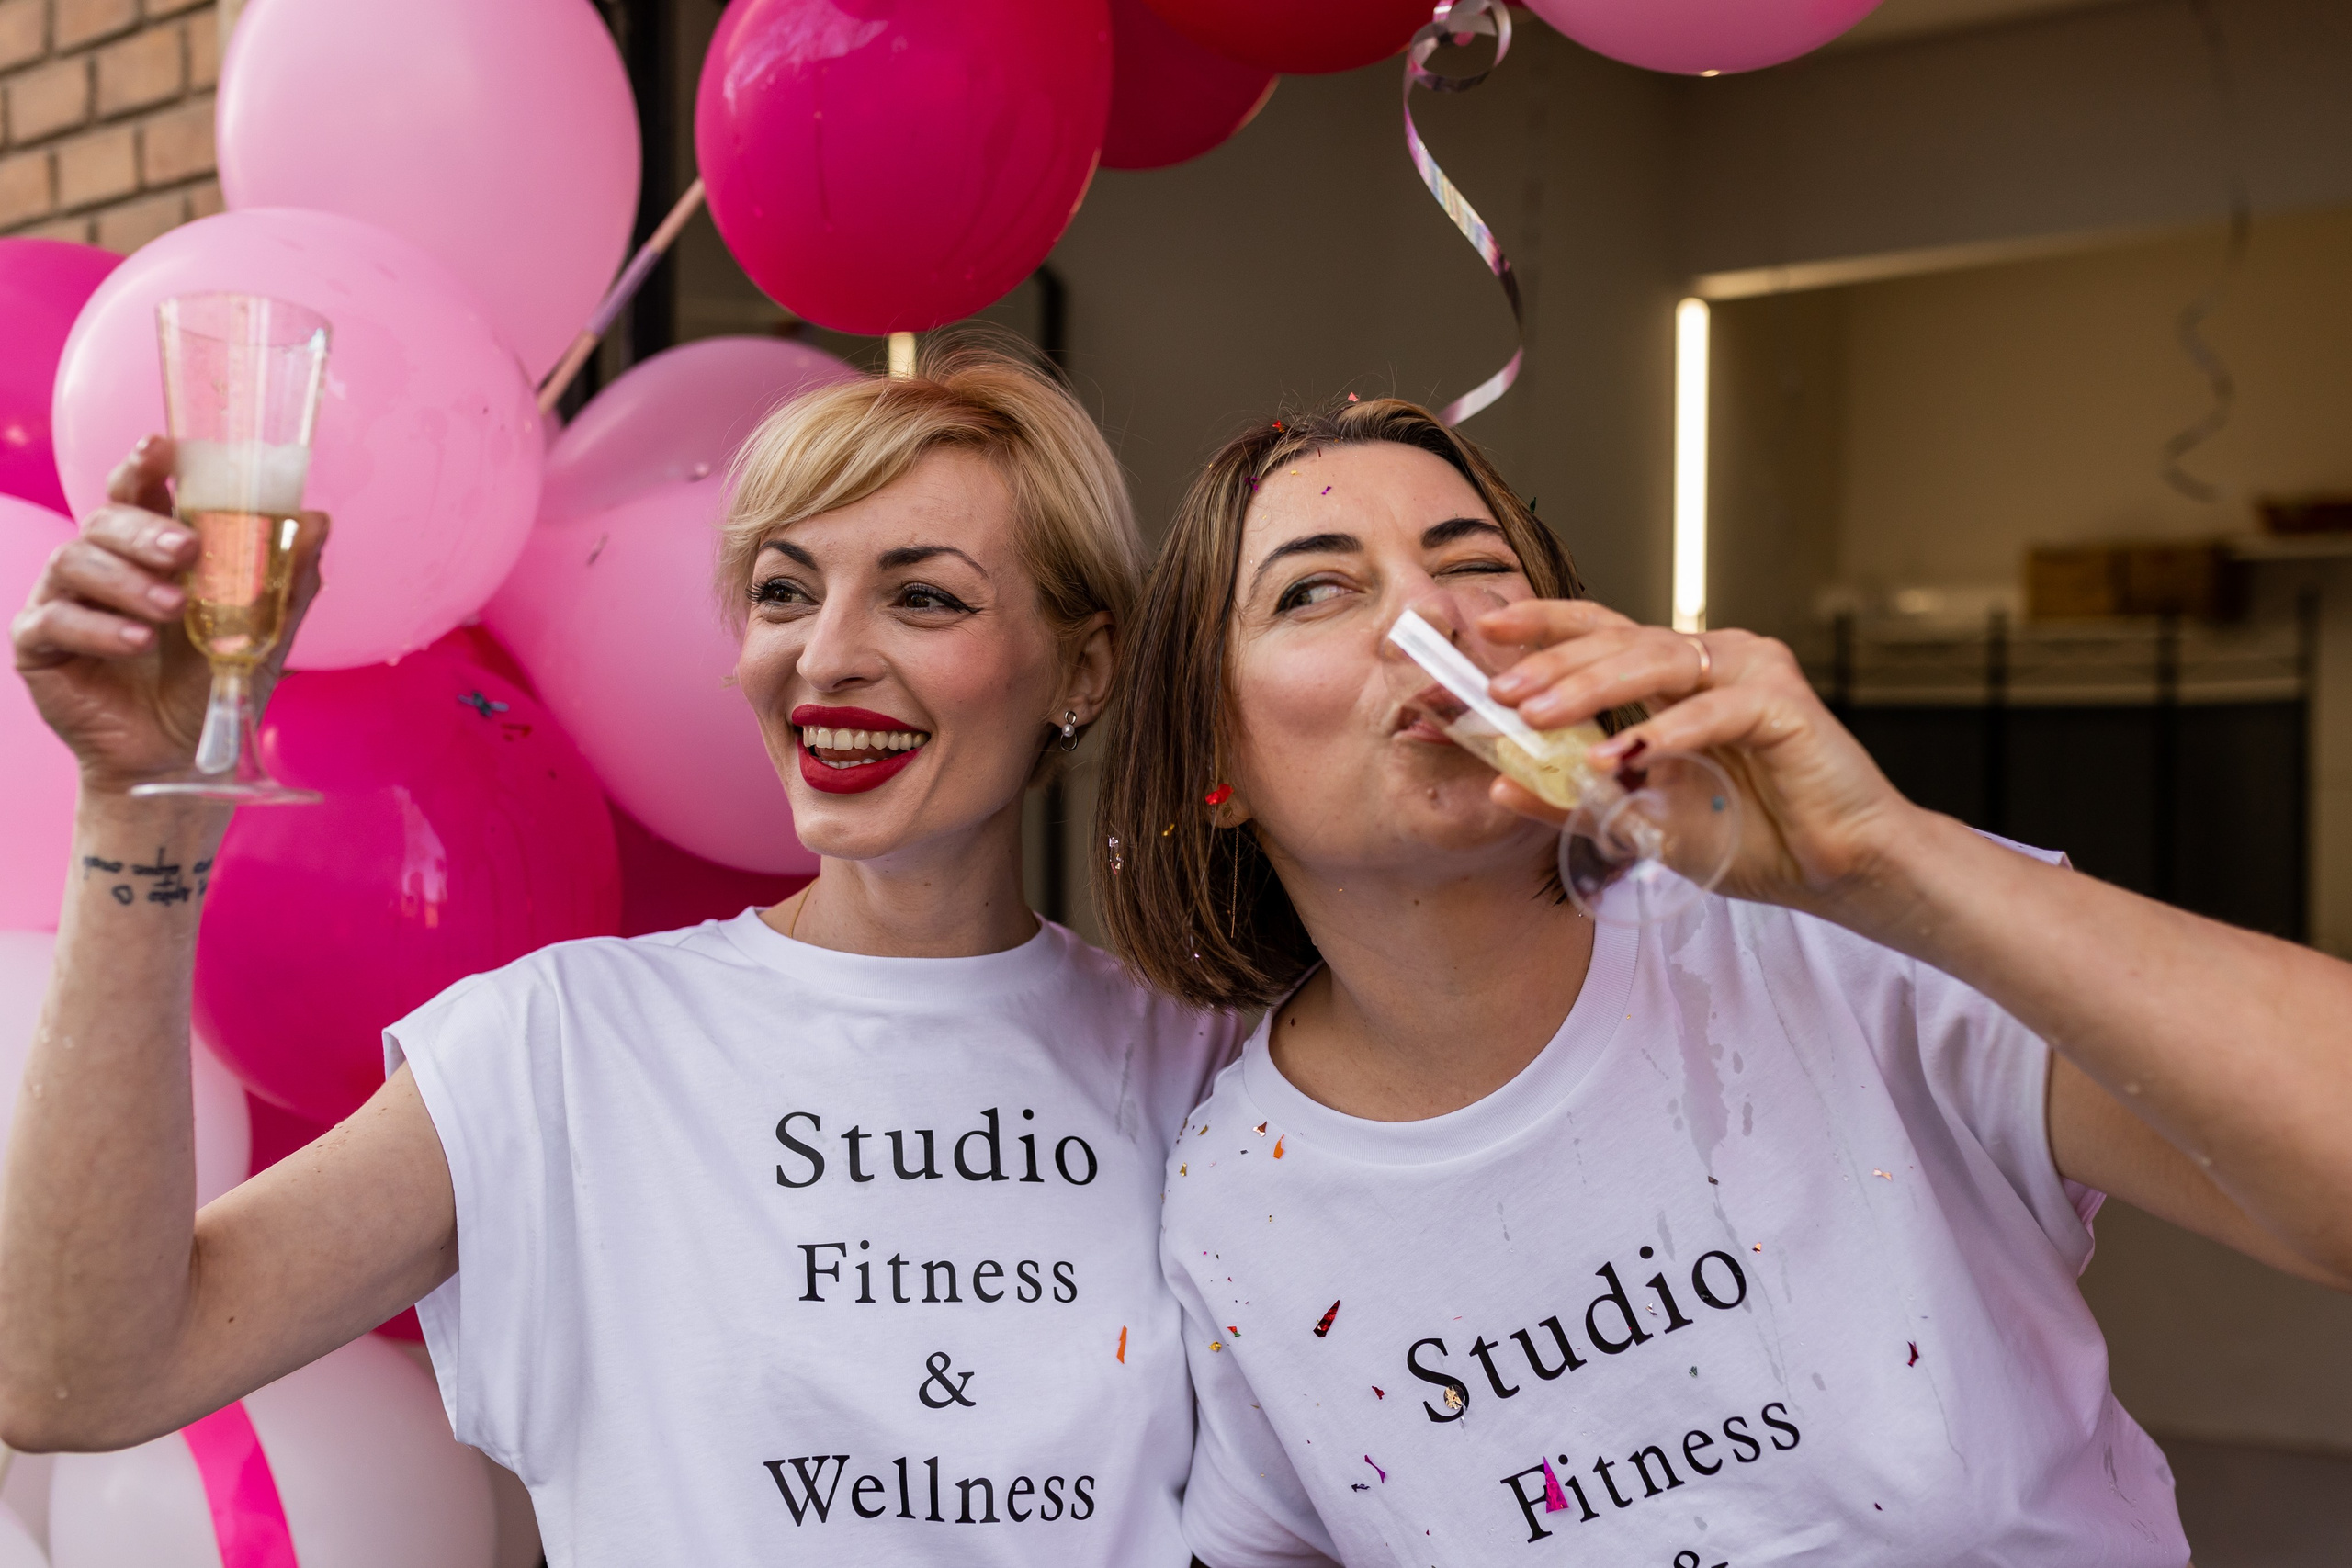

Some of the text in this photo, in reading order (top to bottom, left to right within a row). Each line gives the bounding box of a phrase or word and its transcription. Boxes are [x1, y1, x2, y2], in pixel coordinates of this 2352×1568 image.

[775, 1107, 1098, 1189] Studio
[797, 1240, 1078, 1303] Fitness
[1407, 1246, 1747, 1423] Studio
[919, 1352, 977, 1409] &
[763, 1455, 1095, 1527] Wellness
[1500, 1402, 1801, 1544] Fitness
